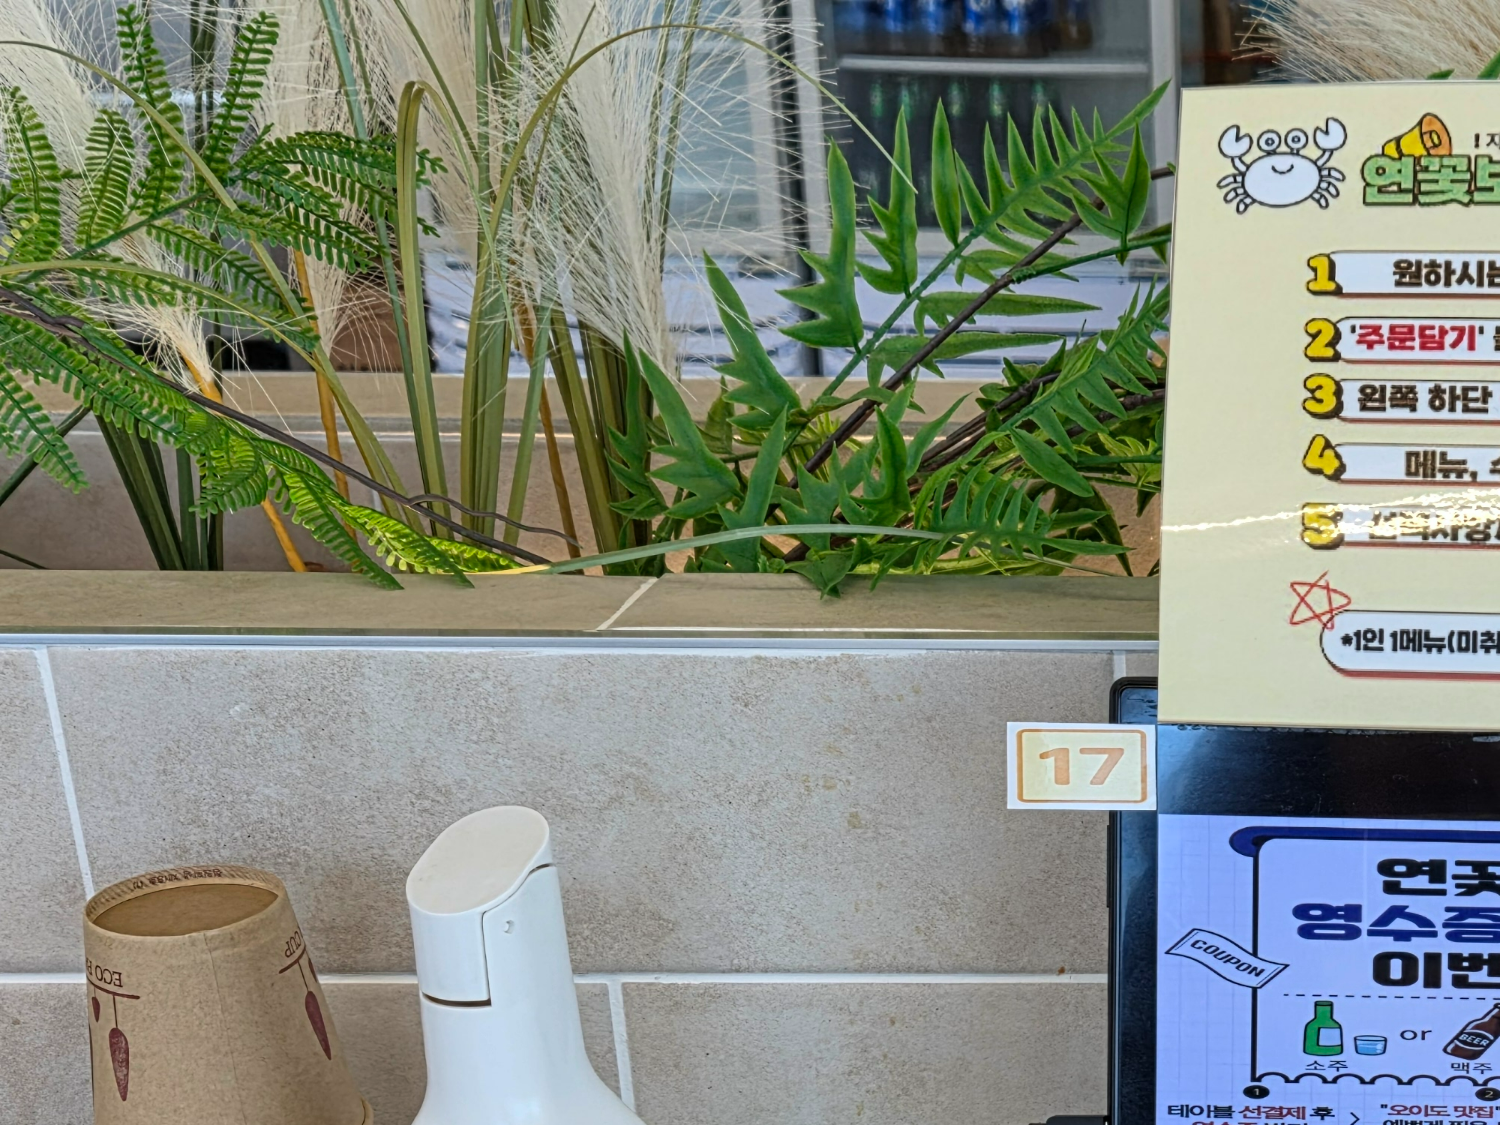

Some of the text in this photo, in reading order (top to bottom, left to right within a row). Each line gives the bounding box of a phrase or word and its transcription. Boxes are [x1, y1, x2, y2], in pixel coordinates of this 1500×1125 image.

[1306, 254, 1343, 294] 1
[1304, 317, 1341, 362] 2
[1350, 324, 1485, 352] '주문담기'
[1303, 373, 1343, 419] 3
[1358, 384, 1418, 413] 왼쪽
[1428, 384, 1493, 413] 하단
[1302, 434, 1346, 480] 4
[1405, 450, 1478, 482] 메뉴,
[1301, 503, 1344, 550] 5
[1039, 748, 1124, 785] 17
[95, 965, 123, 987] ECO
[1191, 939, 1265, 977] COUPON
[1400, 1029, 1432, 1041] or
[1304, 1060, 1348, 1073] 소주
[1451, 1062, 1492, 1075] 맥주
[1168, 1104, 1335, 1120] 테이블 선결제 후
[1381, 1104, 1450, 1117] "오이도
